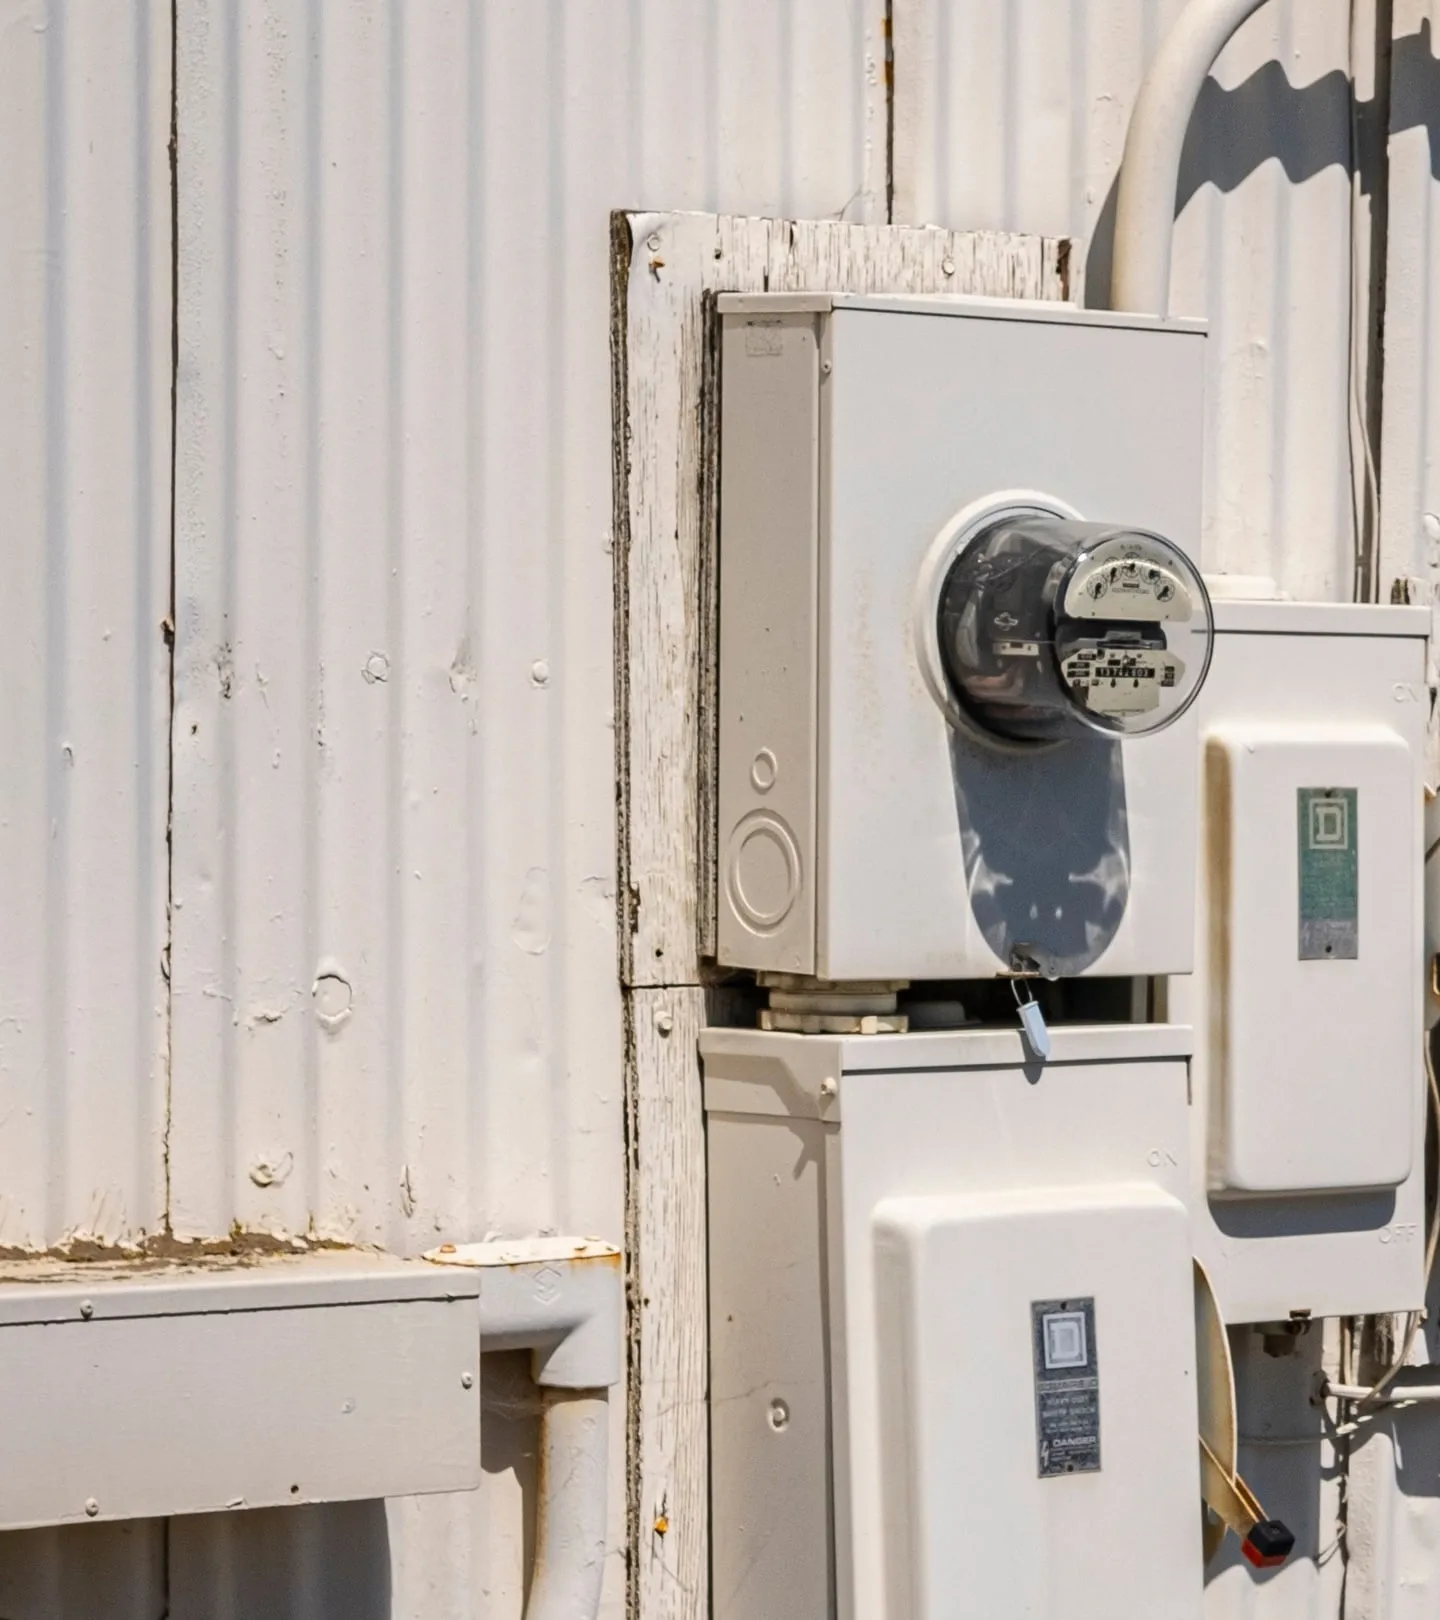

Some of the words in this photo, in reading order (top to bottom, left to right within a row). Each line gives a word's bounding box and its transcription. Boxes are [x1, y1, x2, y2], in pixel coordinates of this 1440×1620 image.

[1390, 682, 1419, 704] ON
[1146, 1147, 1179, 1168] ON
[1378, 1223, 1419, 1244] OFF
[1053, 1436, 1096, 1448] DANGER
